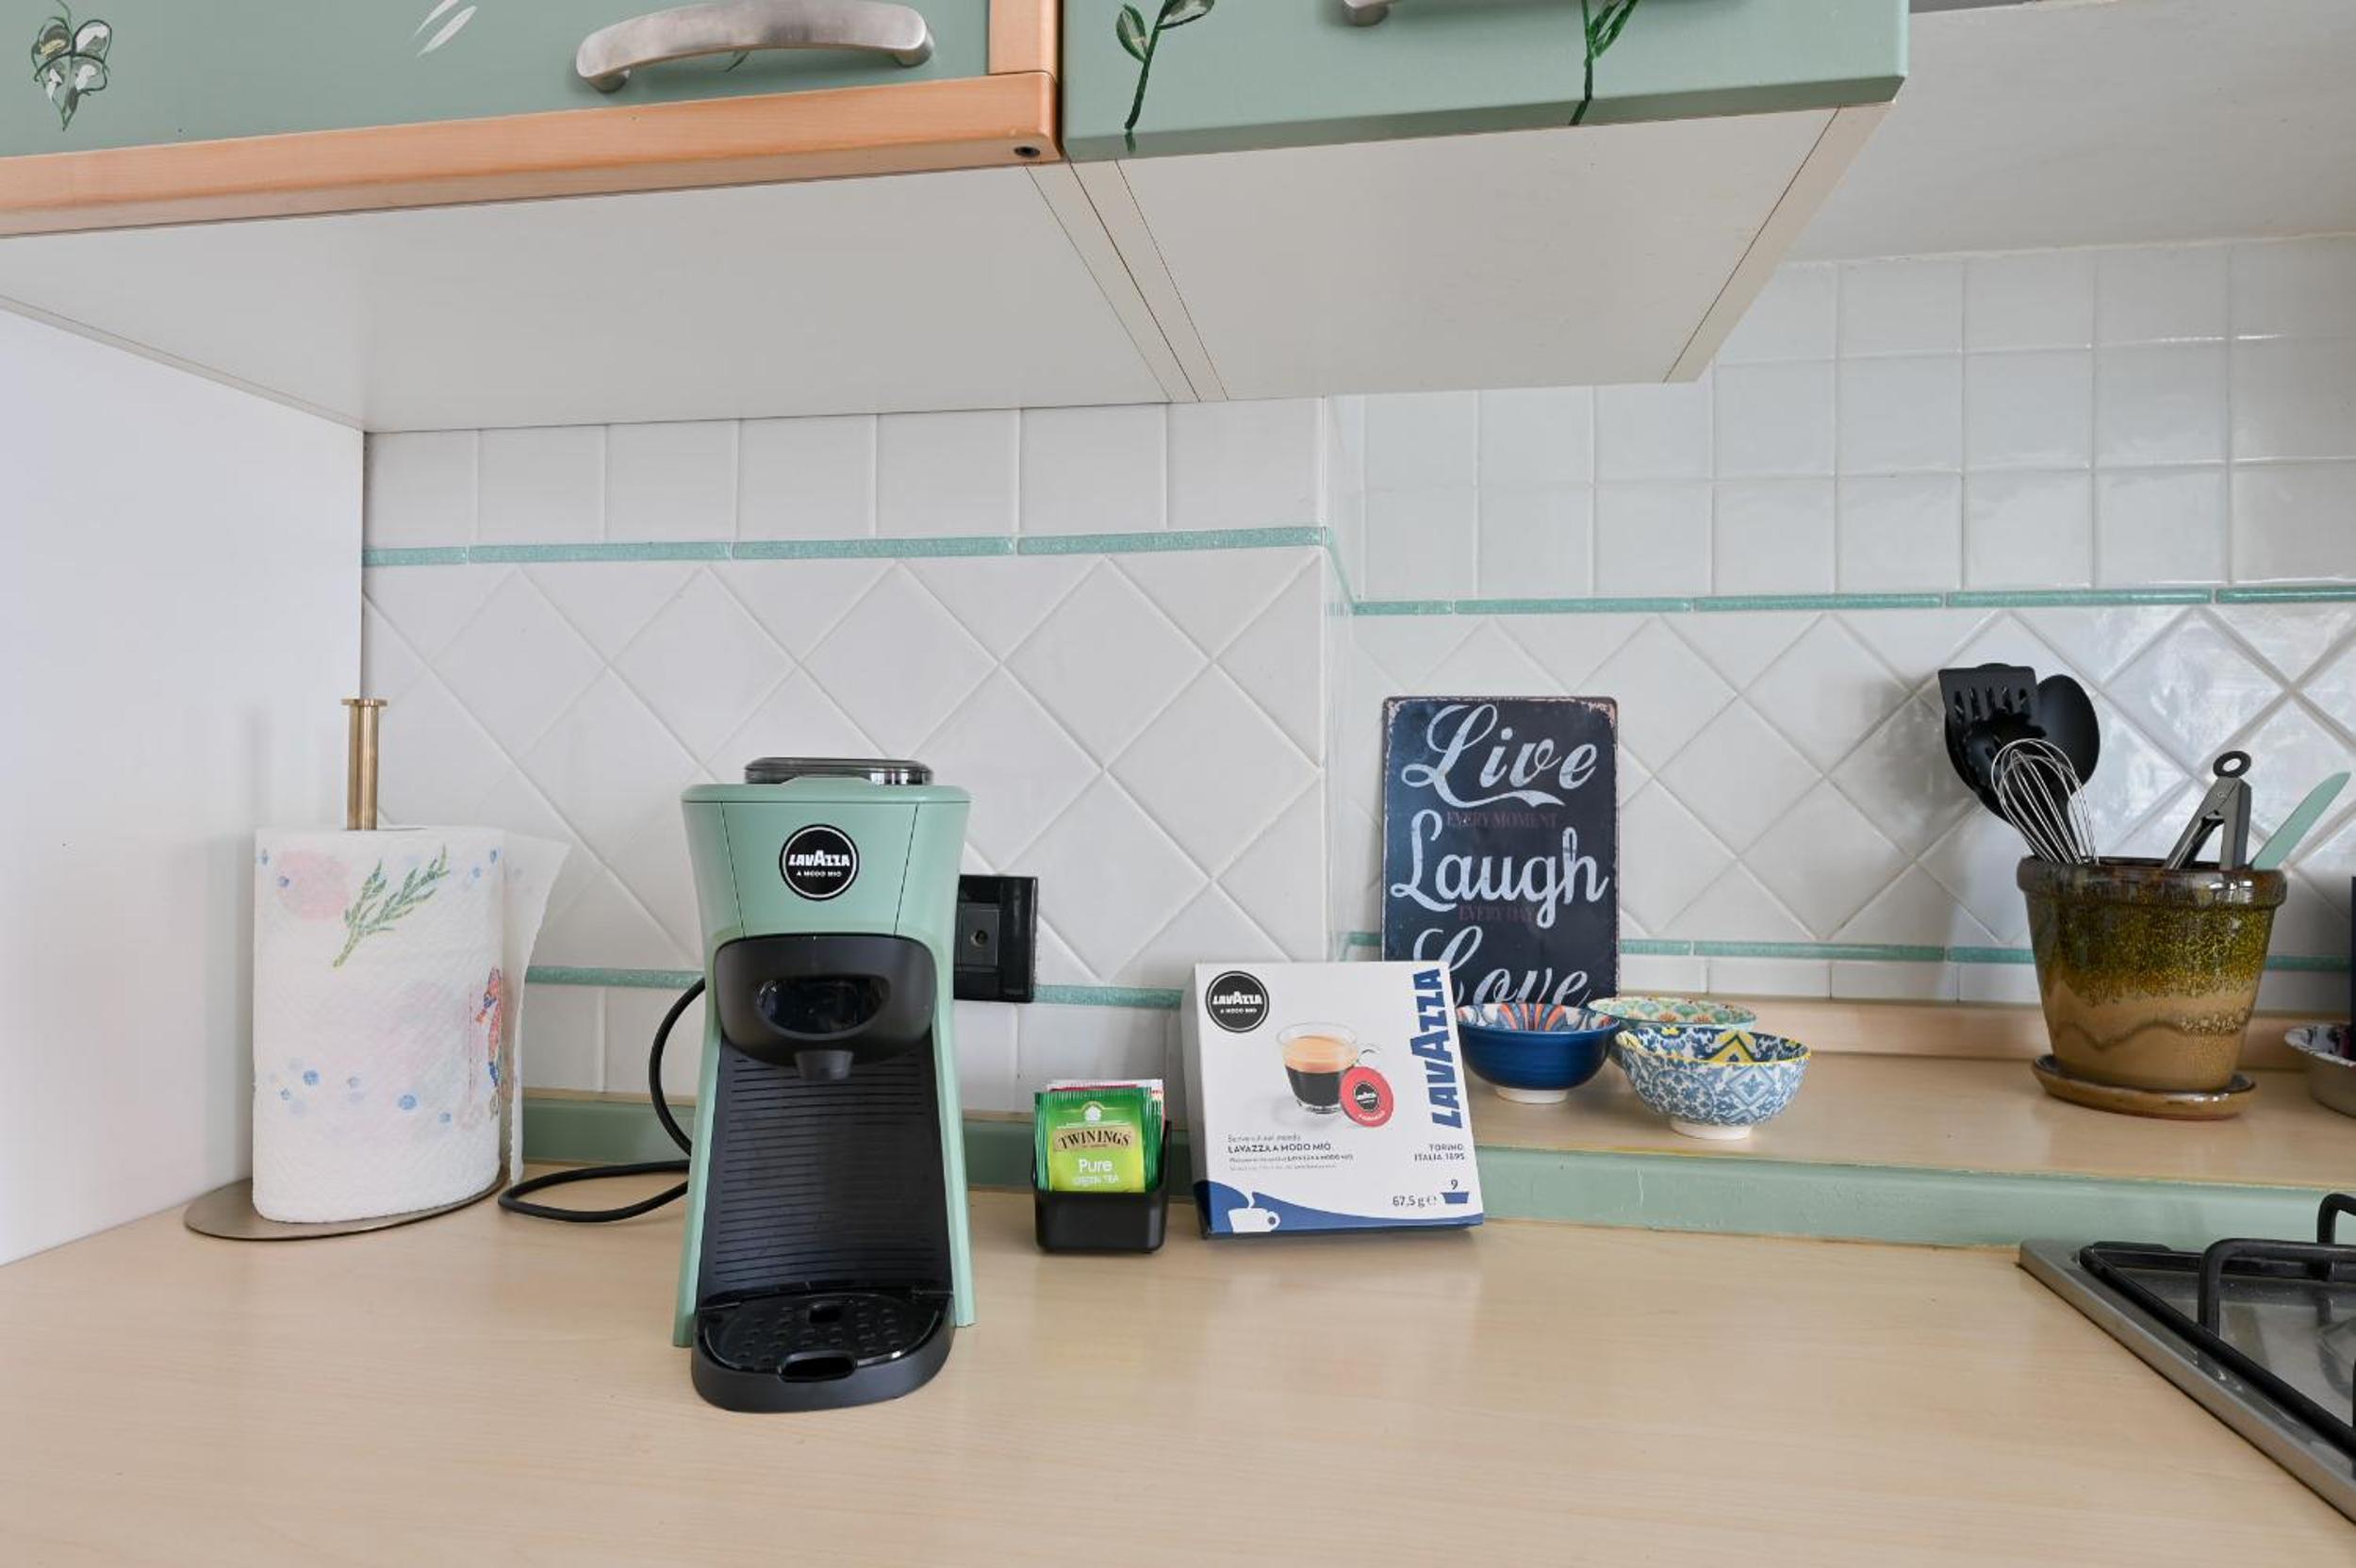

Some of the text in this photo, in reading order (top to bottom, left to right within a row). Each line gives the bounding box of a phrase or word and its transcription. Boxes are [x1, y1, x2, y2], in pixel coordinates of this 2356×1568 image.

[1401, 703, 1597, 808] Live
[1493, 812, 1556, 829] MOMENT
[788, 850, 850, 867] LAVAZZA
[1391, 809, 1609, 929] Laugh
[1211, 991, 1263, 1005] LAVAZZA
[1409, 967, 1463, 1130] LAVAZZA
[1058, 1131, 1130, 1149] TWININGS
[1429, 1143, 1464, 1151] TORINO
[1227, 1145, 1271, 1153] LAVAZZA
[1280, 1143, 1310, 1151] MODO
[1414, 1152, 1465, 1162] ITALIA 1895
[1079, 1159, 1113, 1173] Pure
[1450, 1179, 1458, 1190] 9
